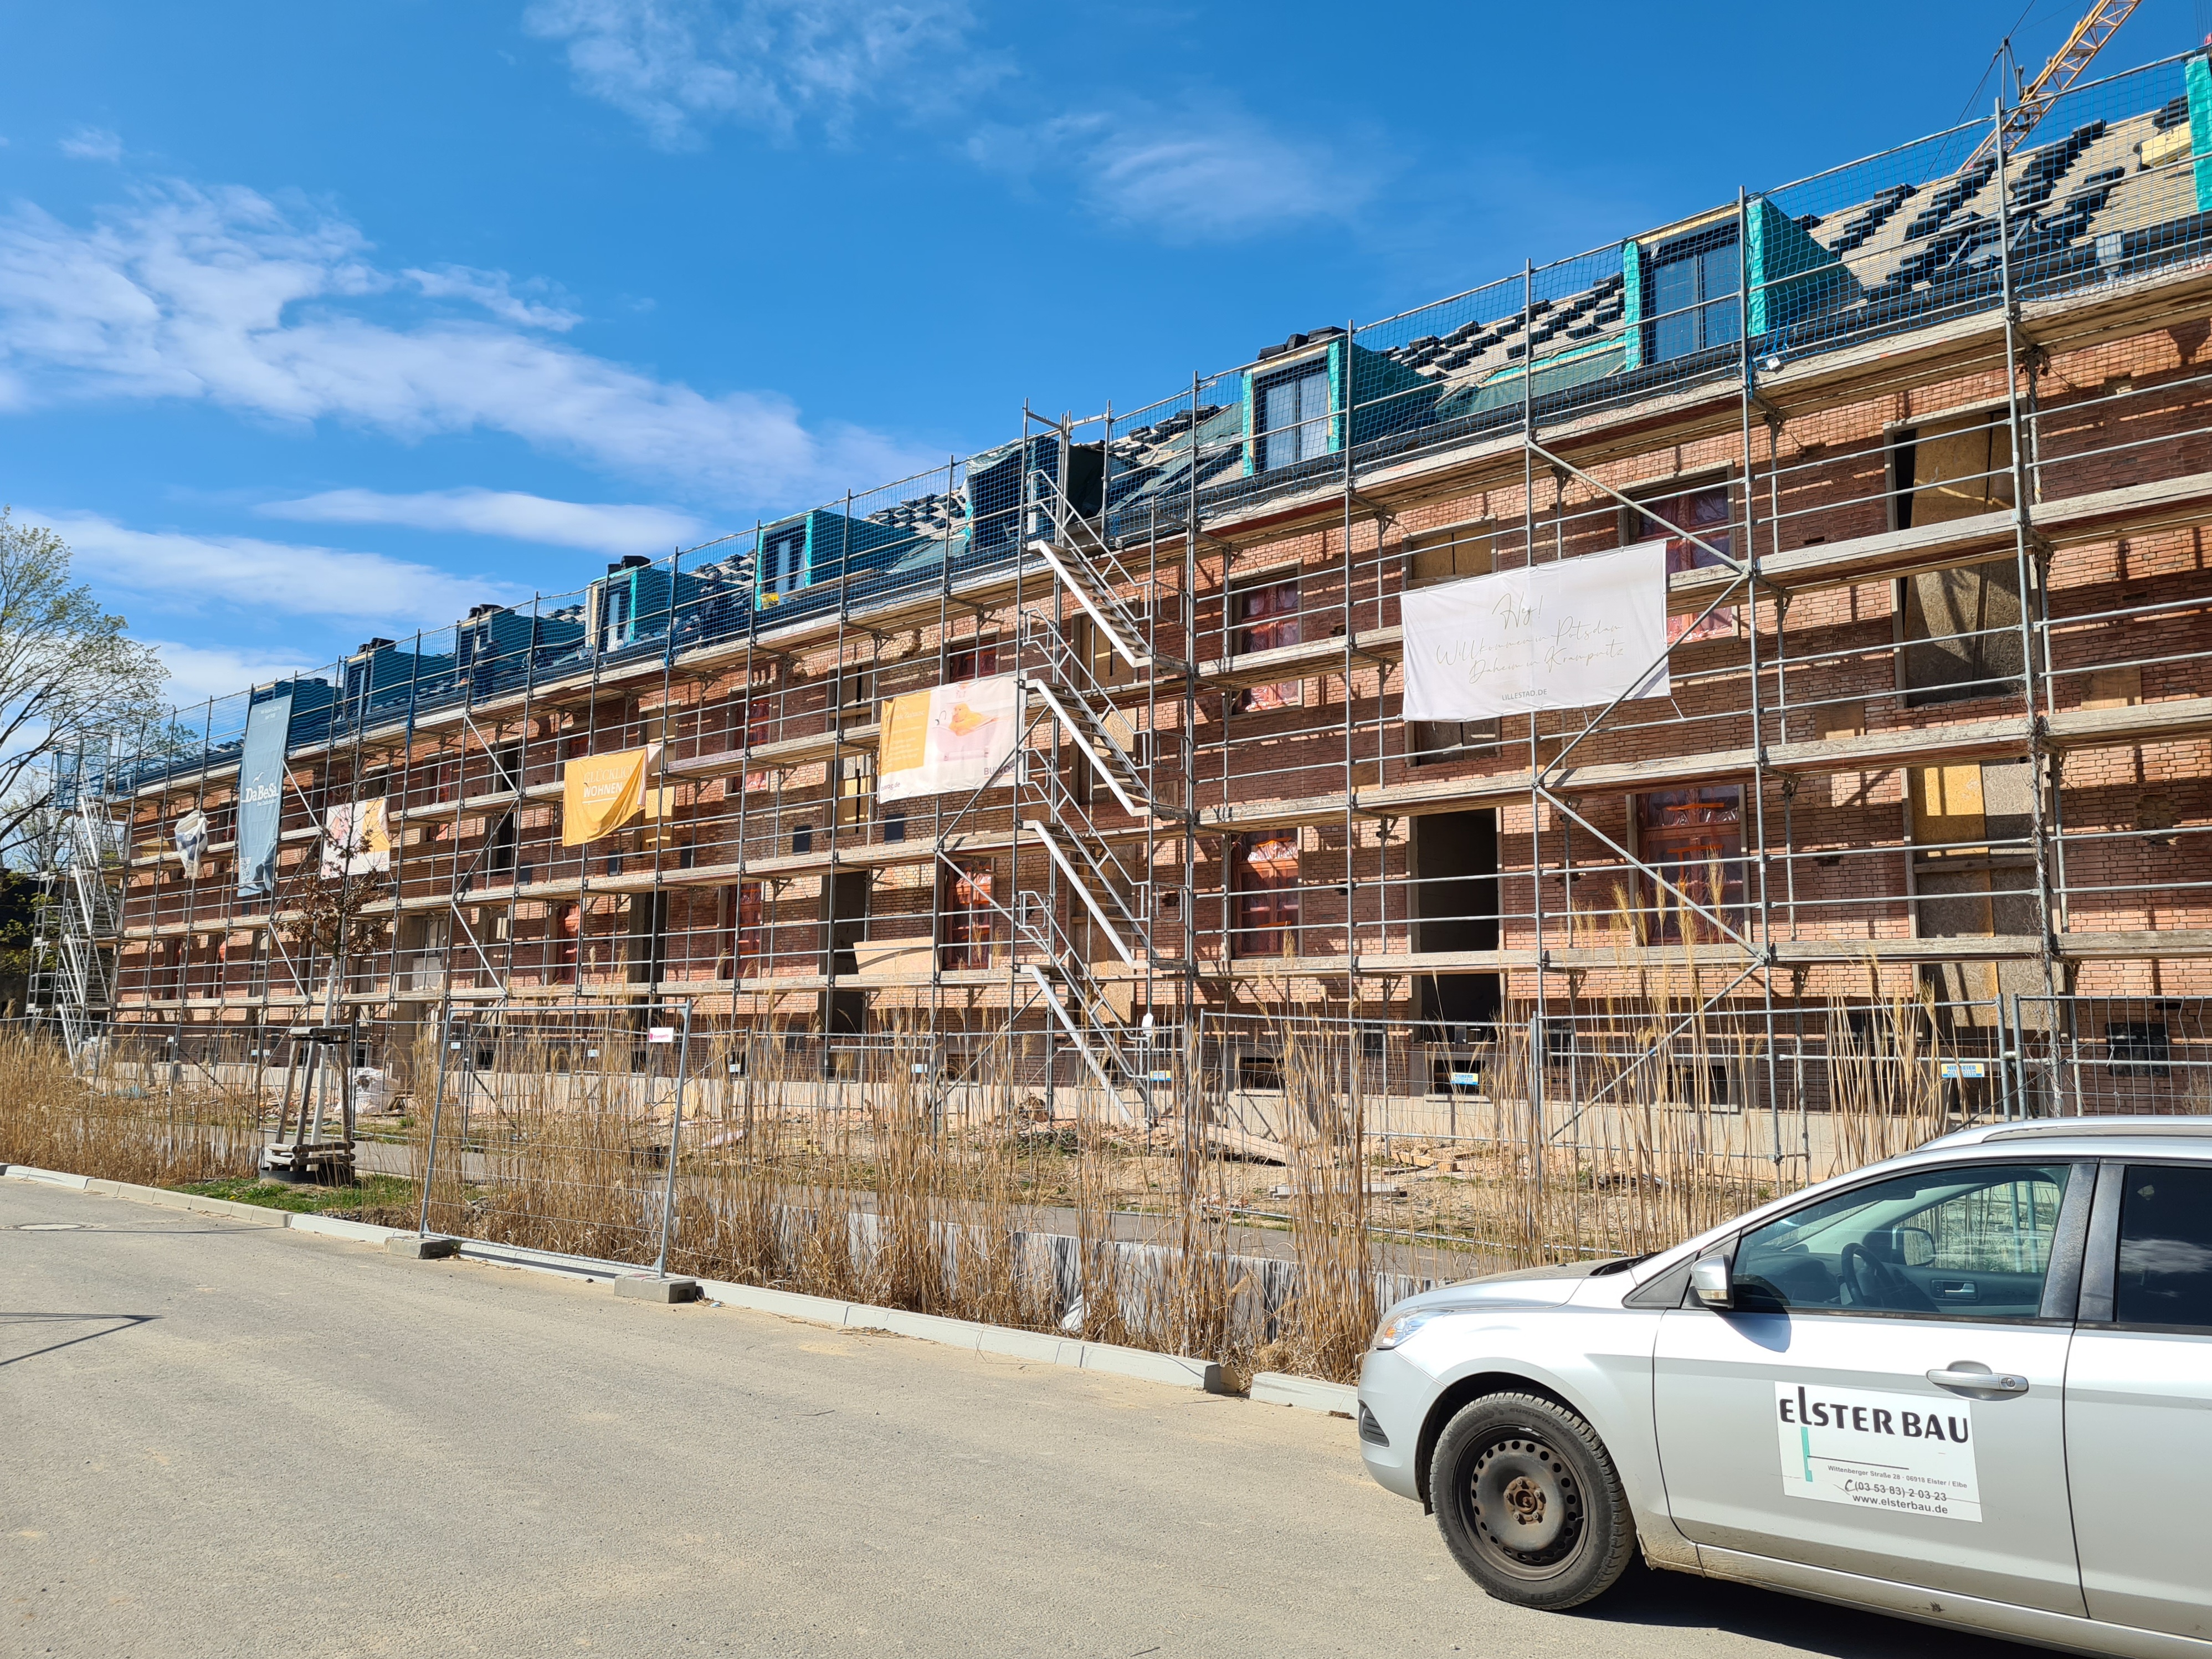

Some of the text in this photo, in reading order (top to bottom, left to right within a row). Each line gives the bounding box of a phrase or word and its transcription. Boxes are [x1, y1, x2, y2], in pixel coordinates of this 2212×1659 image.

[1492, 591, 1543, 630] Hey!
[1436, 637, 1533, 666] Willkommen
[1551, 616, 1624, 647] Potsdam
[1469, 656, 1524, 684] Daheim
[1544, 638, 1624, 673] Krampnitz
[1501, 688, 1548, 702] LILLESTAD.DE
[243, 782, 279, 803] DaBeSa
[583, 782, 623, 798] WOHNEN
[1509, 1407, 1568, 1437] EUROWINTER
[1828, 1465, 1869, 1476] Wittenberger
[1870, 1471, 1891, 1479] Straße
[1906, 1475, 1925, 1483] 06918
[1927, 1478, 1947, 1486] Elster
[1874, 1484, 1886, 1493] 53
[1908, 1488, 1915, 1497] 2
[1918, 1489, 1931, 1499] 03
[1934, 1492, 1947, 1501] 23
[1852, 1494, 1948, 1514] www.elsterbau.de
